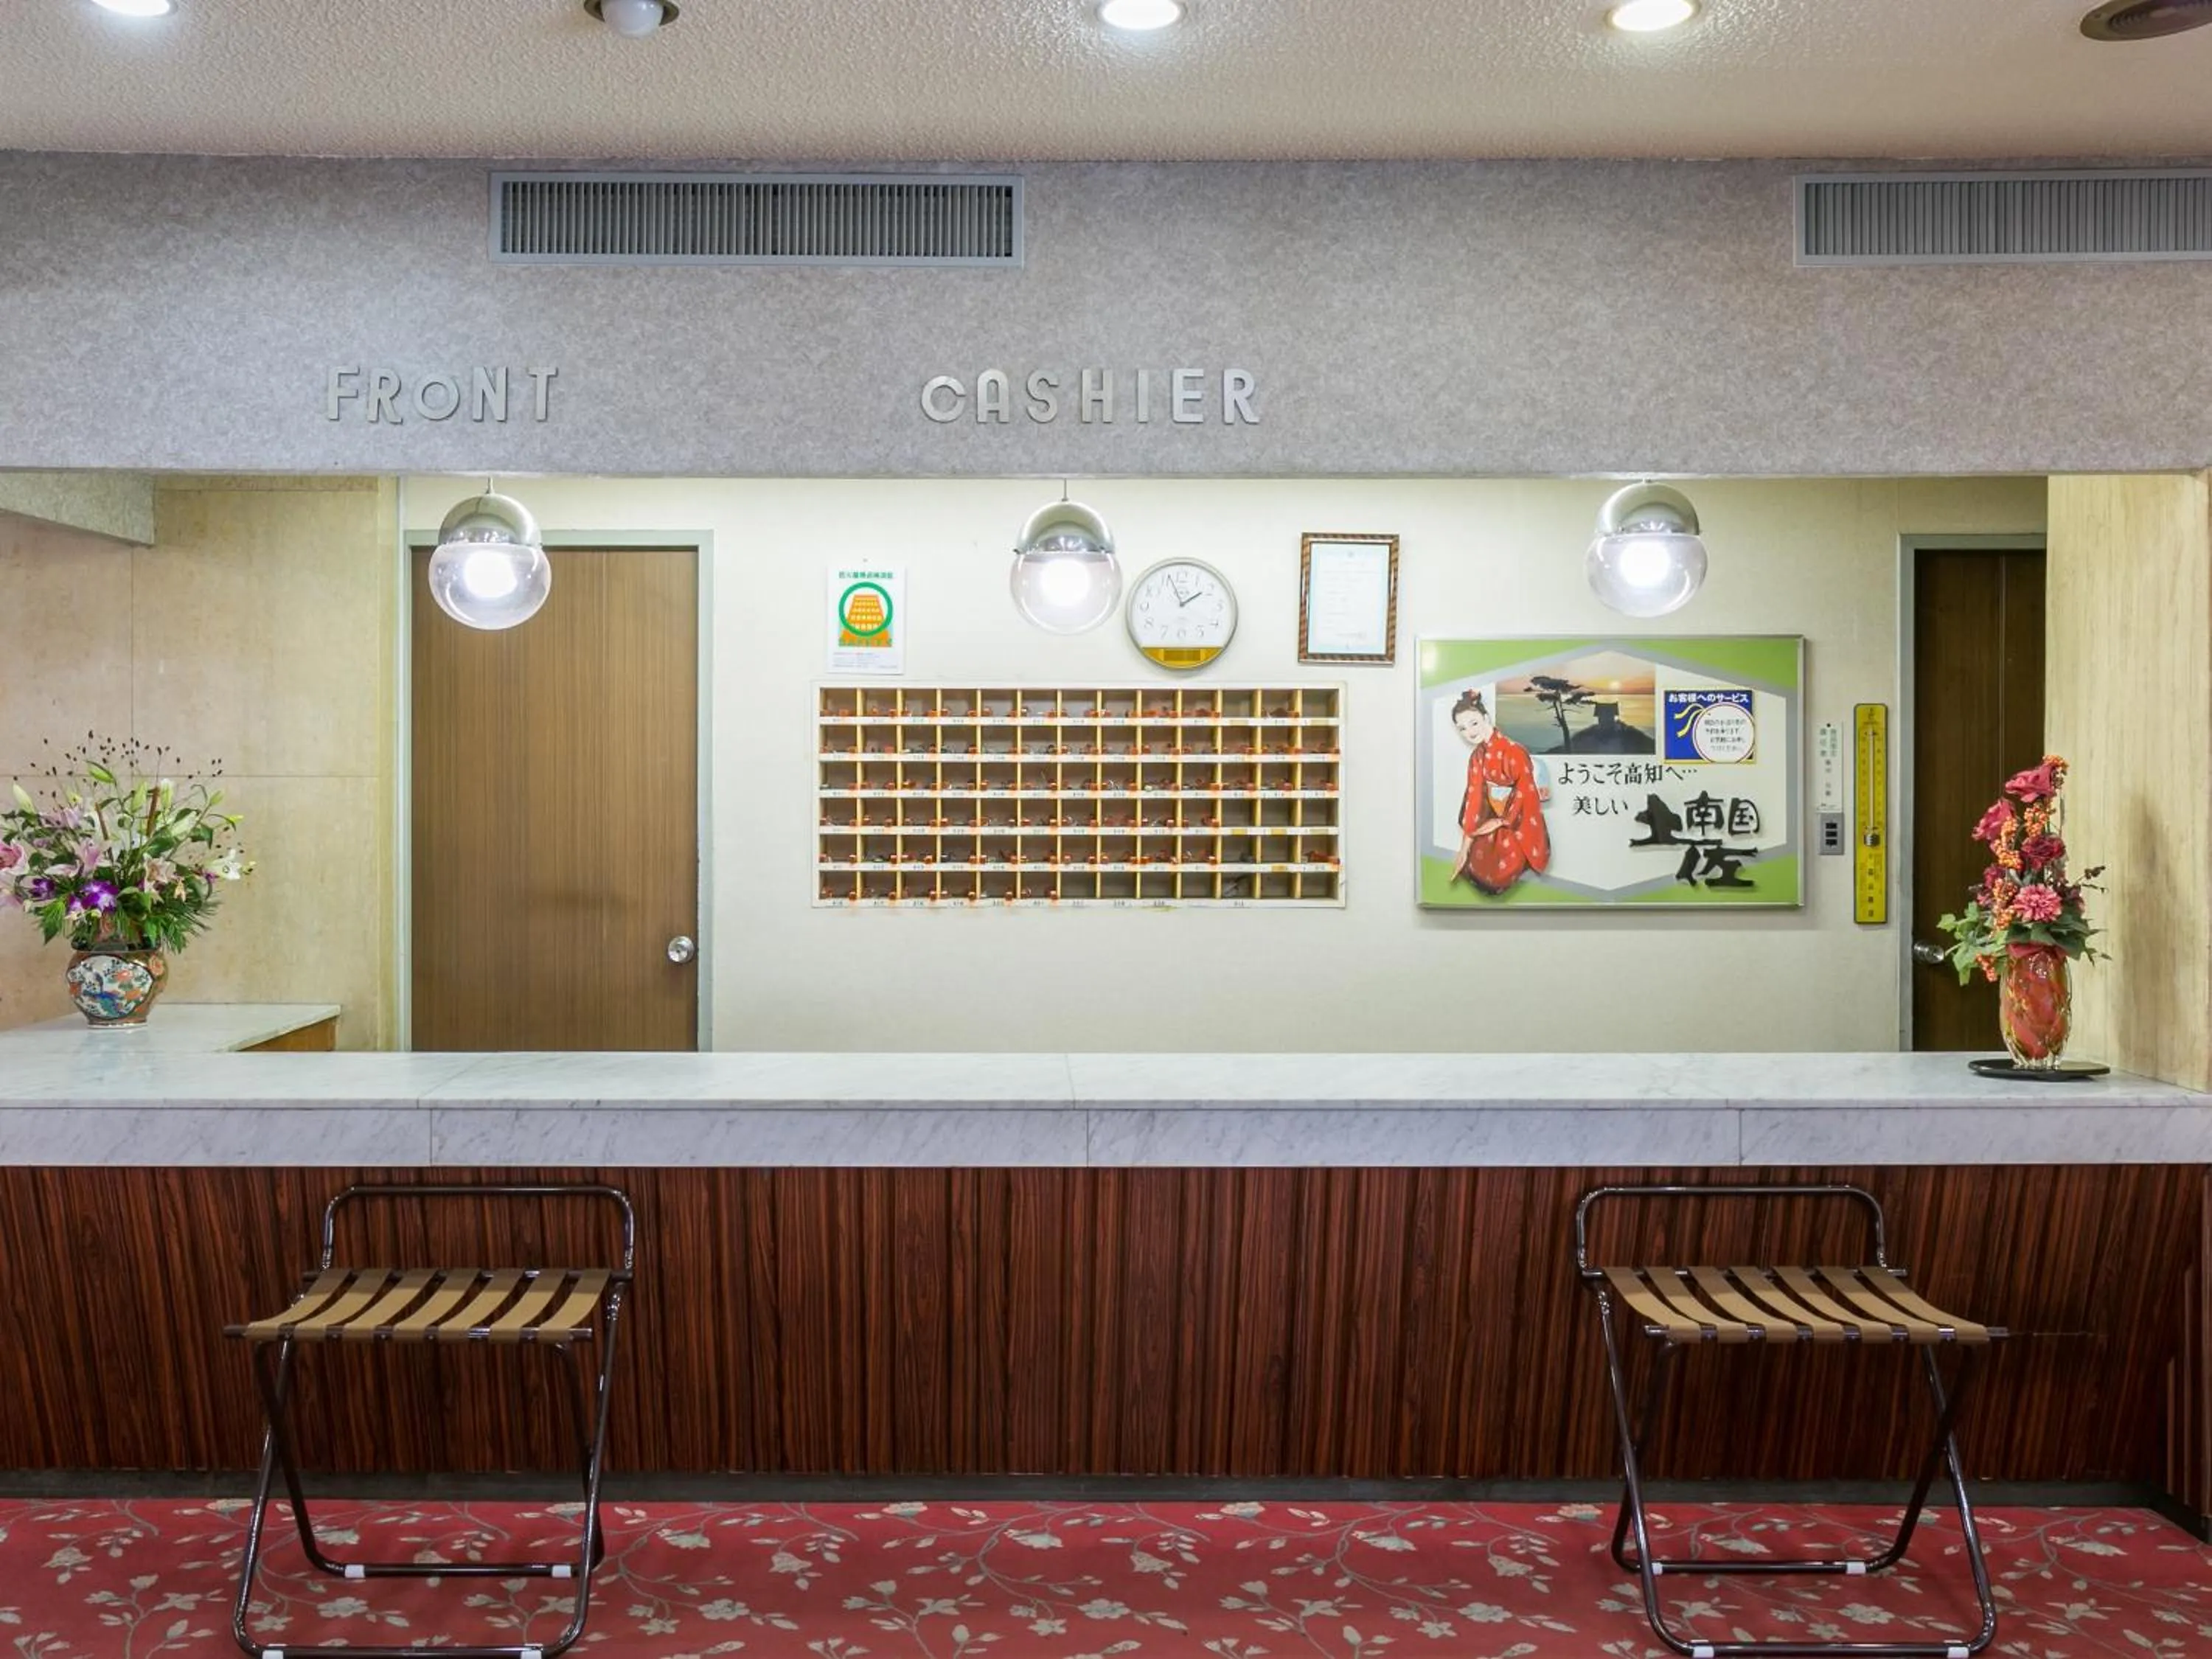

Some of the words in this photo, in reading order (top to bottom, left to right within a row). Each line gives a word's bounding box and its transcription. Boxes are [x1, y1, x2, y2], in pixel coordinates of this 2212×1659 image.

[327, 366, 559, 424] FRONT
[921, 368, 1261, 425] CASHIER
[1669, 692, 1750, 703] お客様へのサービス
[1573, 795, 1630, 816] 美しい
[1683, 790, 1761, 836] 南国
